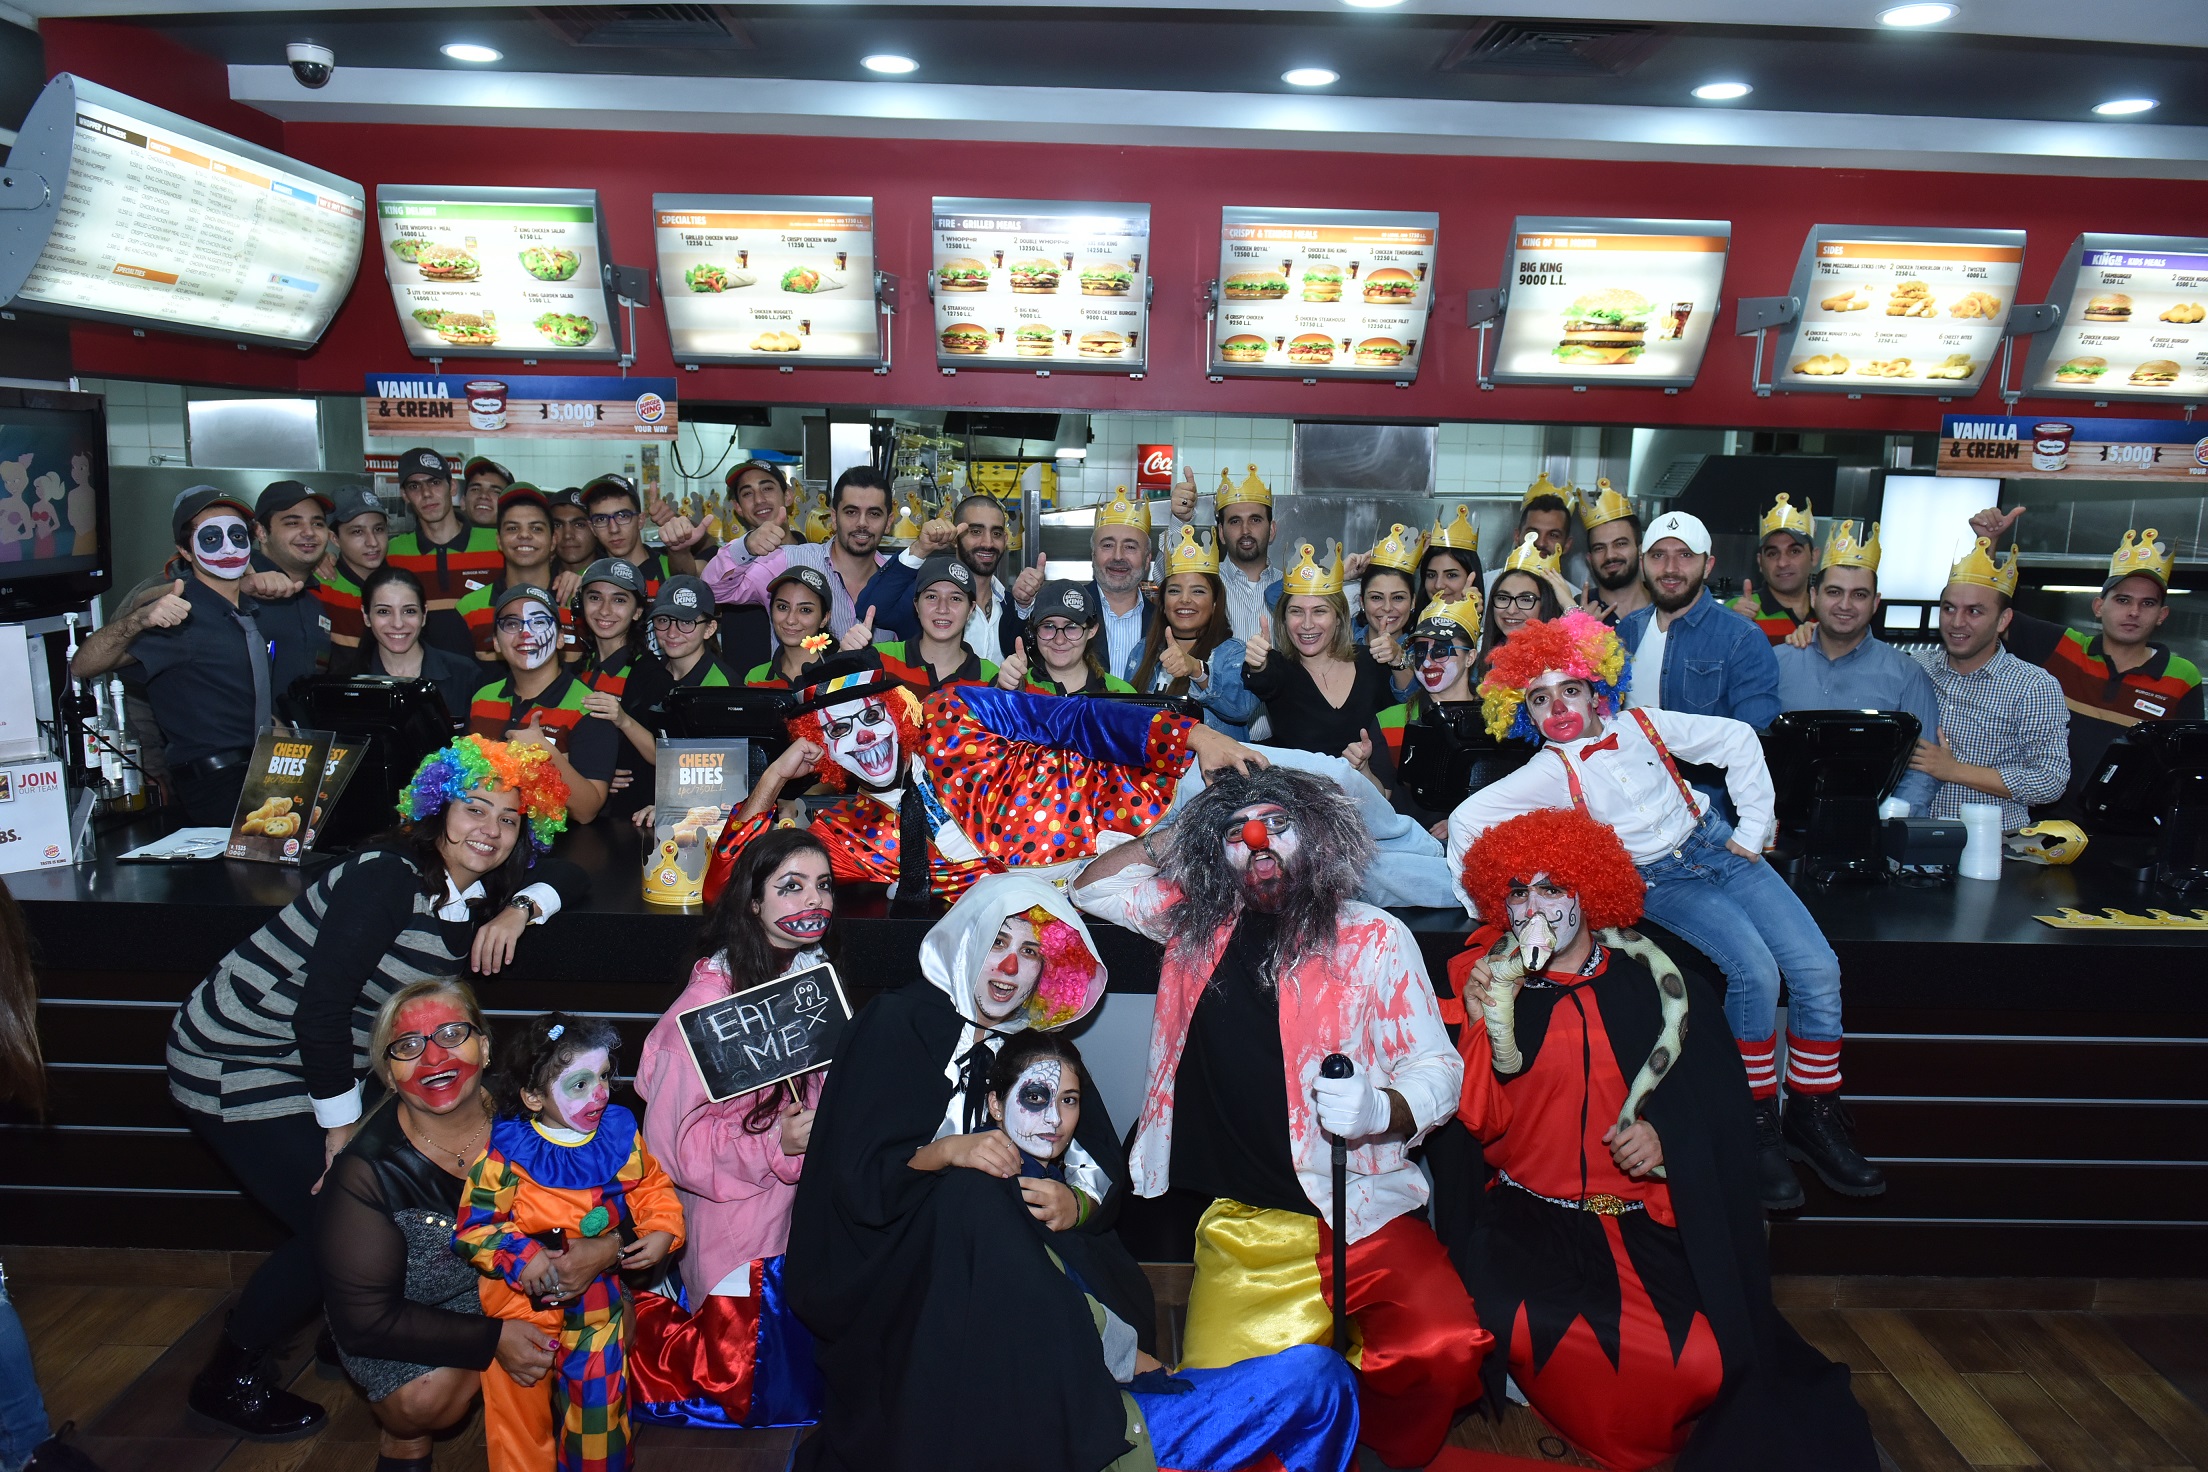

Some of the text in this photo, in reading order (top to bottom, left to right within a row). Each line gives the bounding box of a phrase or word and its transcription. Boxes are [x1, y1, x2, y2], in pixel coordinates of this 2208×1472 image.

[385, 206, 436, 216] KING DELIGHT
[662, 216, 706, 225] SPECIALTIES
[938, 219, 1021, 230] FIRE GRILLED MEALS
[1230, 228, 1318, 240] CRISPY & TENDER MEALS
[1522, 238, 1540, 246] KING
[1543, 238, 1552, 247] OF
[1823, 246, 1844, 255] SIDES
[1520, 262, 1562, 272] BIG KING
[2144, 258, 2166, 266] MEALS
[1519, 274, 1566, 285] 9000 L.L.
[377, 380, 449, 398] VANILLA
[379, 400, 454, 418] & CREAM
[640, 399, 660, 408] BURGER
[550, 402, 594, 421] 5,000
[640, 404, 661, 416] KING
[1953, 422, 2018, 440] VANILLA
[1950, 442, 2020, 459] & CREAM
[2109, 446, 2152, 463] 5,000
[614, 570, 633, 578] KING
[952, 569, 968, 580] KING
[273, 742, 312, 758] CHEESY
[268, 756, 306, 776] BITES
[679, 754, 724, 768] CHEESY
[18, 771, 57, 788] JOIN
[680, 768, 723, 785] BITES
[38, 785, 58, 793] TEAM
[707, 994, 780, 1042] EAT
[744, 1020, 809, 1070] ME
